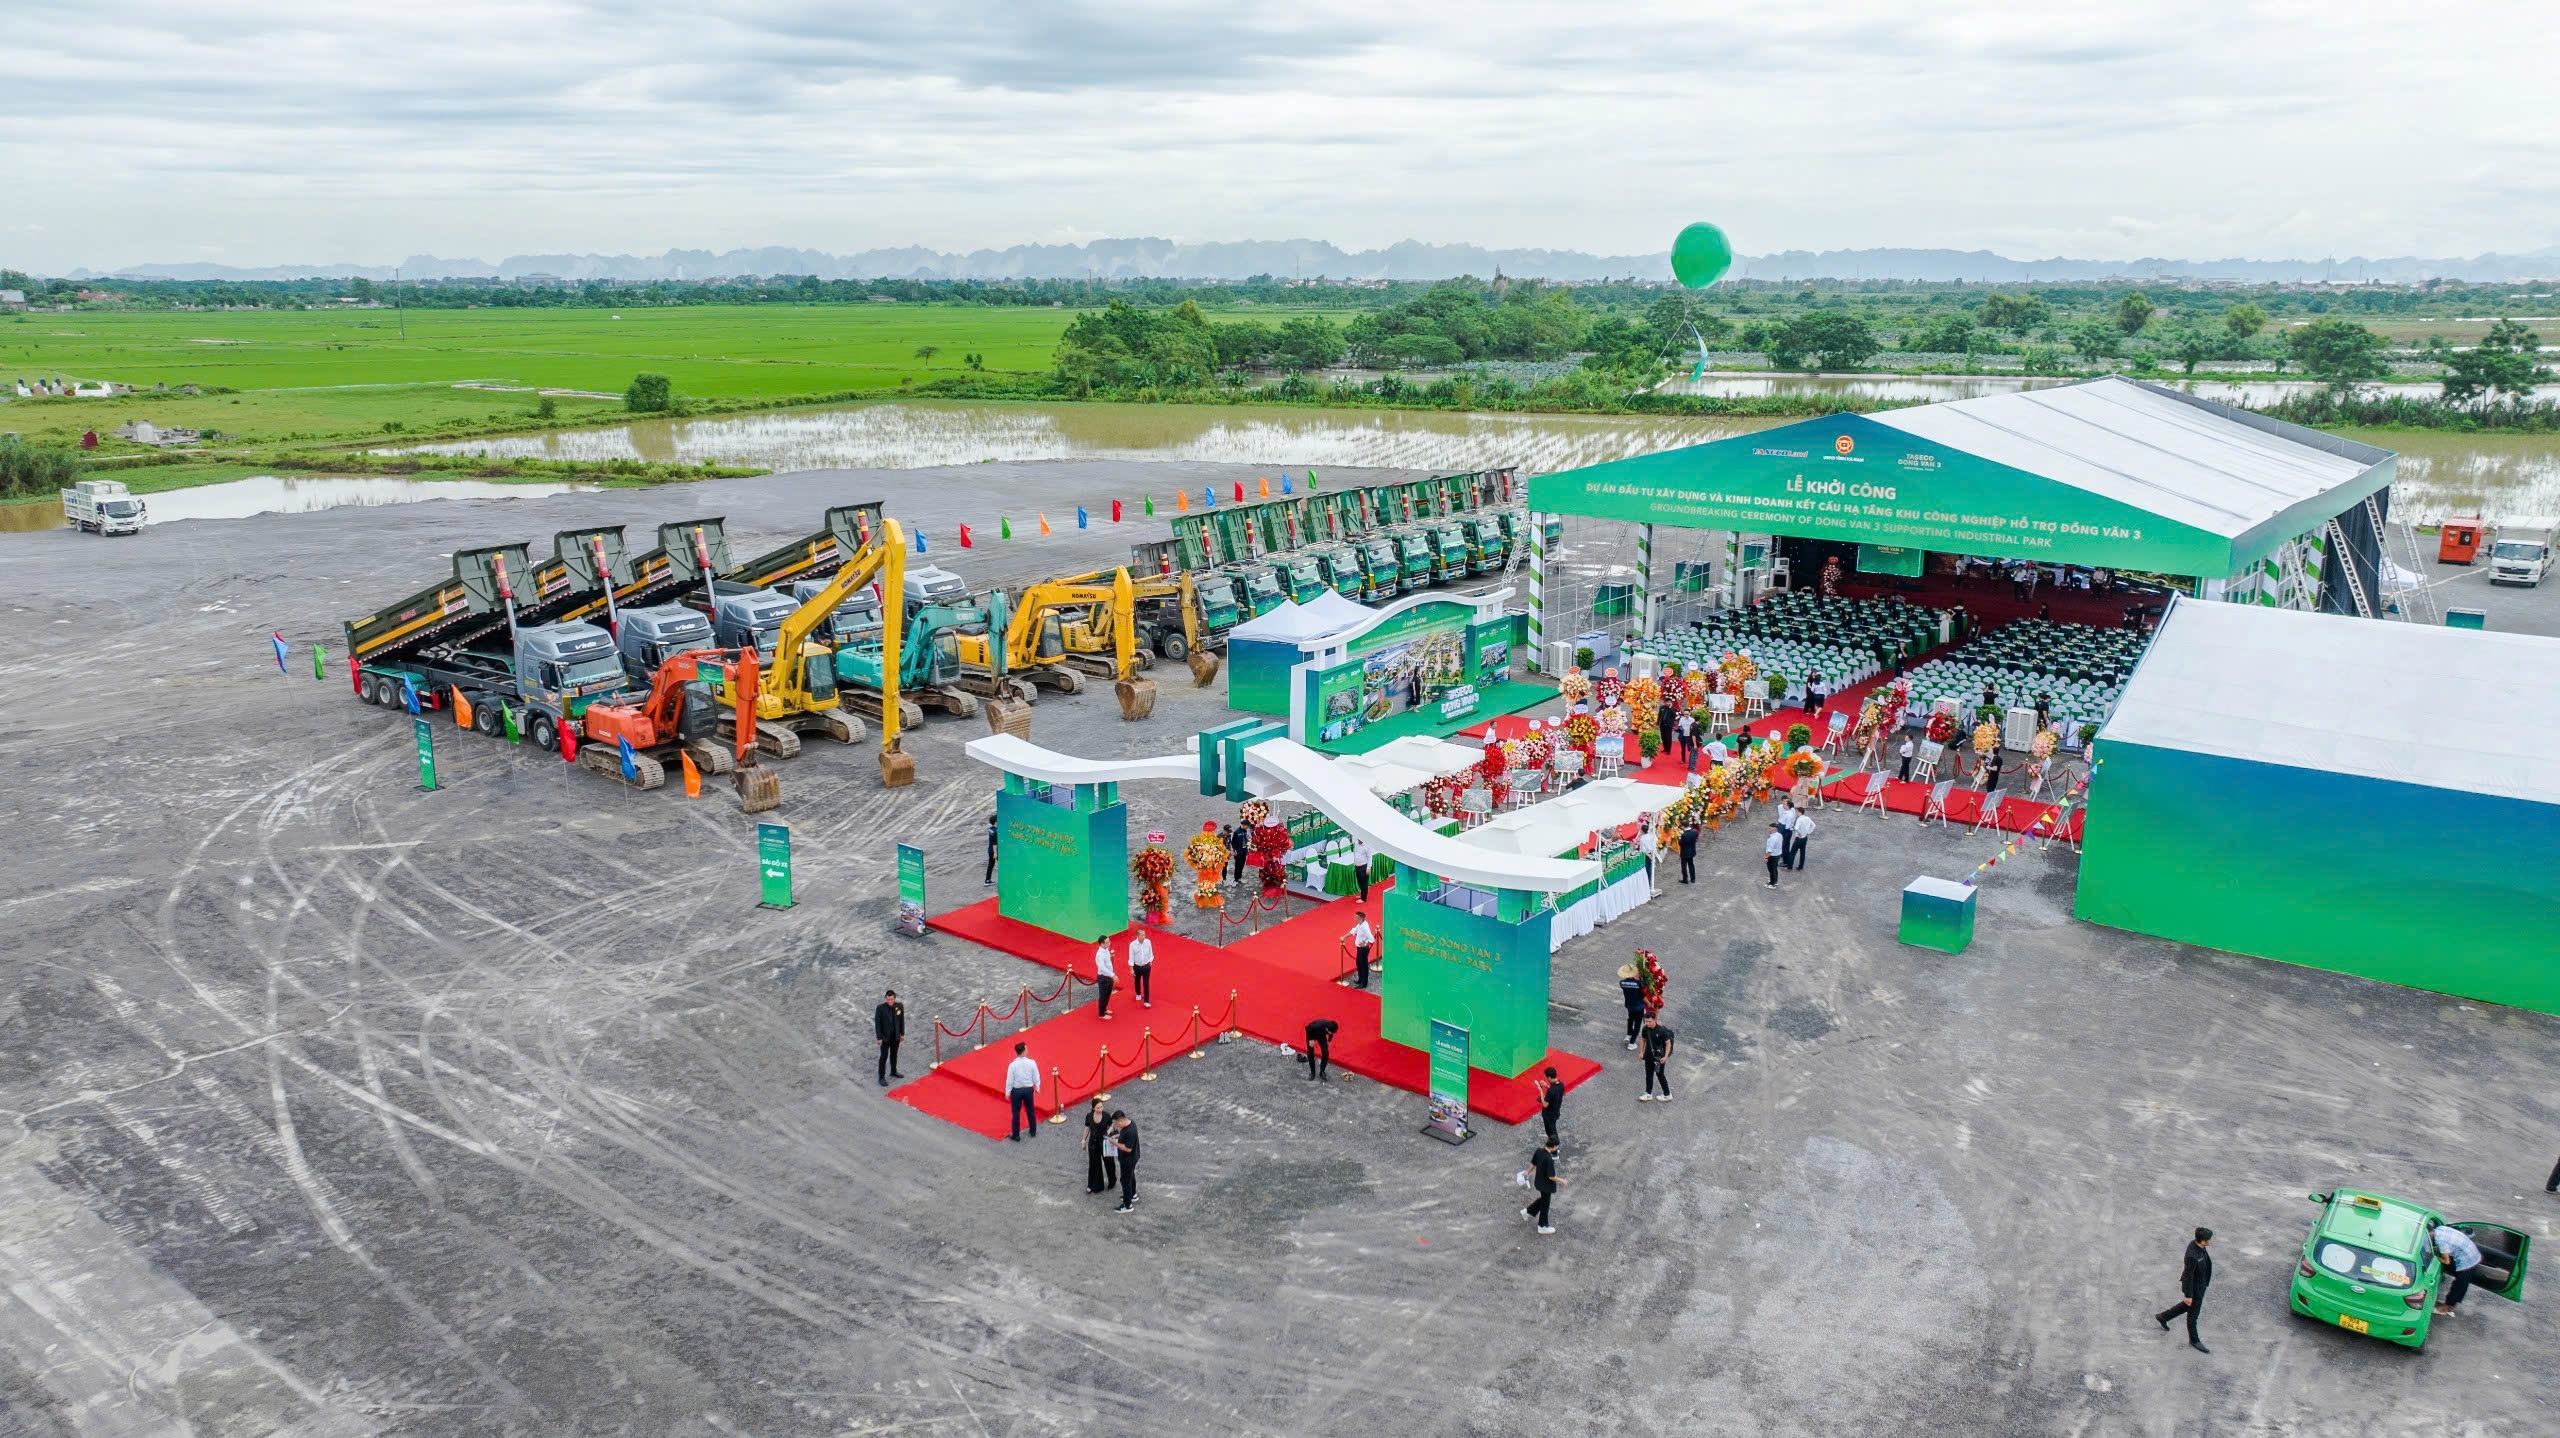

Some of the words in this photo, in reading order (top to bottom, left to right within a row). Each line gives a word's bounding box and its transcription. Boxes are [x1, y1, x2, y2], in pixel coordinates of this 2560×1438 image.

[1906, 453, 1935, 461] TASECO
[1920, 460, 1936, 468] VAN
[1786, 474, 1803, 493] LỄ
[1806, 478, 1846, 496] KHỞI
[1849, 482, 1897, 500] CÔNG
[1585, 482, 1600, 494] DỰ
[1602, 481, 1616, 493] ÁN
[1618, 483, 1639, 496] ĐẦU
[1640, 485, 1655, 497] TƯ
[1656, 486, 1676, 498] XÂY
[1677, 490, 1707, 502] DỰNG
[1709, 490, 1723, 502] VÀ
[1725, 494, 1751, 505] KINH
[1754, 497, 1793, 508] DOANH
[1796, 496, 1816, 510] KẾT
[1818, 499, 1841, 513] CẤU
[1843, 503, 1861, 516] HẠ
[1862, 501, 1893, 518] TẦNG
[1895, 510, 1921, 520] KHU
[1923, 509, 1958, 524] CÔNG
[1961, 514, 2007, 528] NGHIỆP
[2010, 515, 2029, 530] HỖ
[2032, 520, 2058, 535] TRỢ
[2060, 520, 2099, 536] ĐỒNG
[2102, 524, 2130, 538] VĂN
[2132, 529, 2142, 540] 3
[1650, 502, 1738, 519] GROUNDBREAKING
[1740, 510, 1795, 524] CEREMONY
[1798, 514, 1813, 525] OF
[1815, 518, 1847, 529] DONG
[1849, 520, 1872, 531] VAN
[1872, 522, 1880, 532] 3
[1882, 523, 1951, 539] SUPPORTING
[1954, 530, 2021, 546] INDUSTRIAL
[2022, 536, 2052, 548] PARK
[546, 578, 568, 592] SINOTRUK
[1400, 927, 1436, 944] TASECO
[1439, 937, 1468, 953] DONG
[1471, 945, 1491, 959] VAN
[1494, 952, 1501, 962] 3
[1404, 941, 1462, 964] INDUSTRIAL
[1466, 957, 1493, 973] PARK
